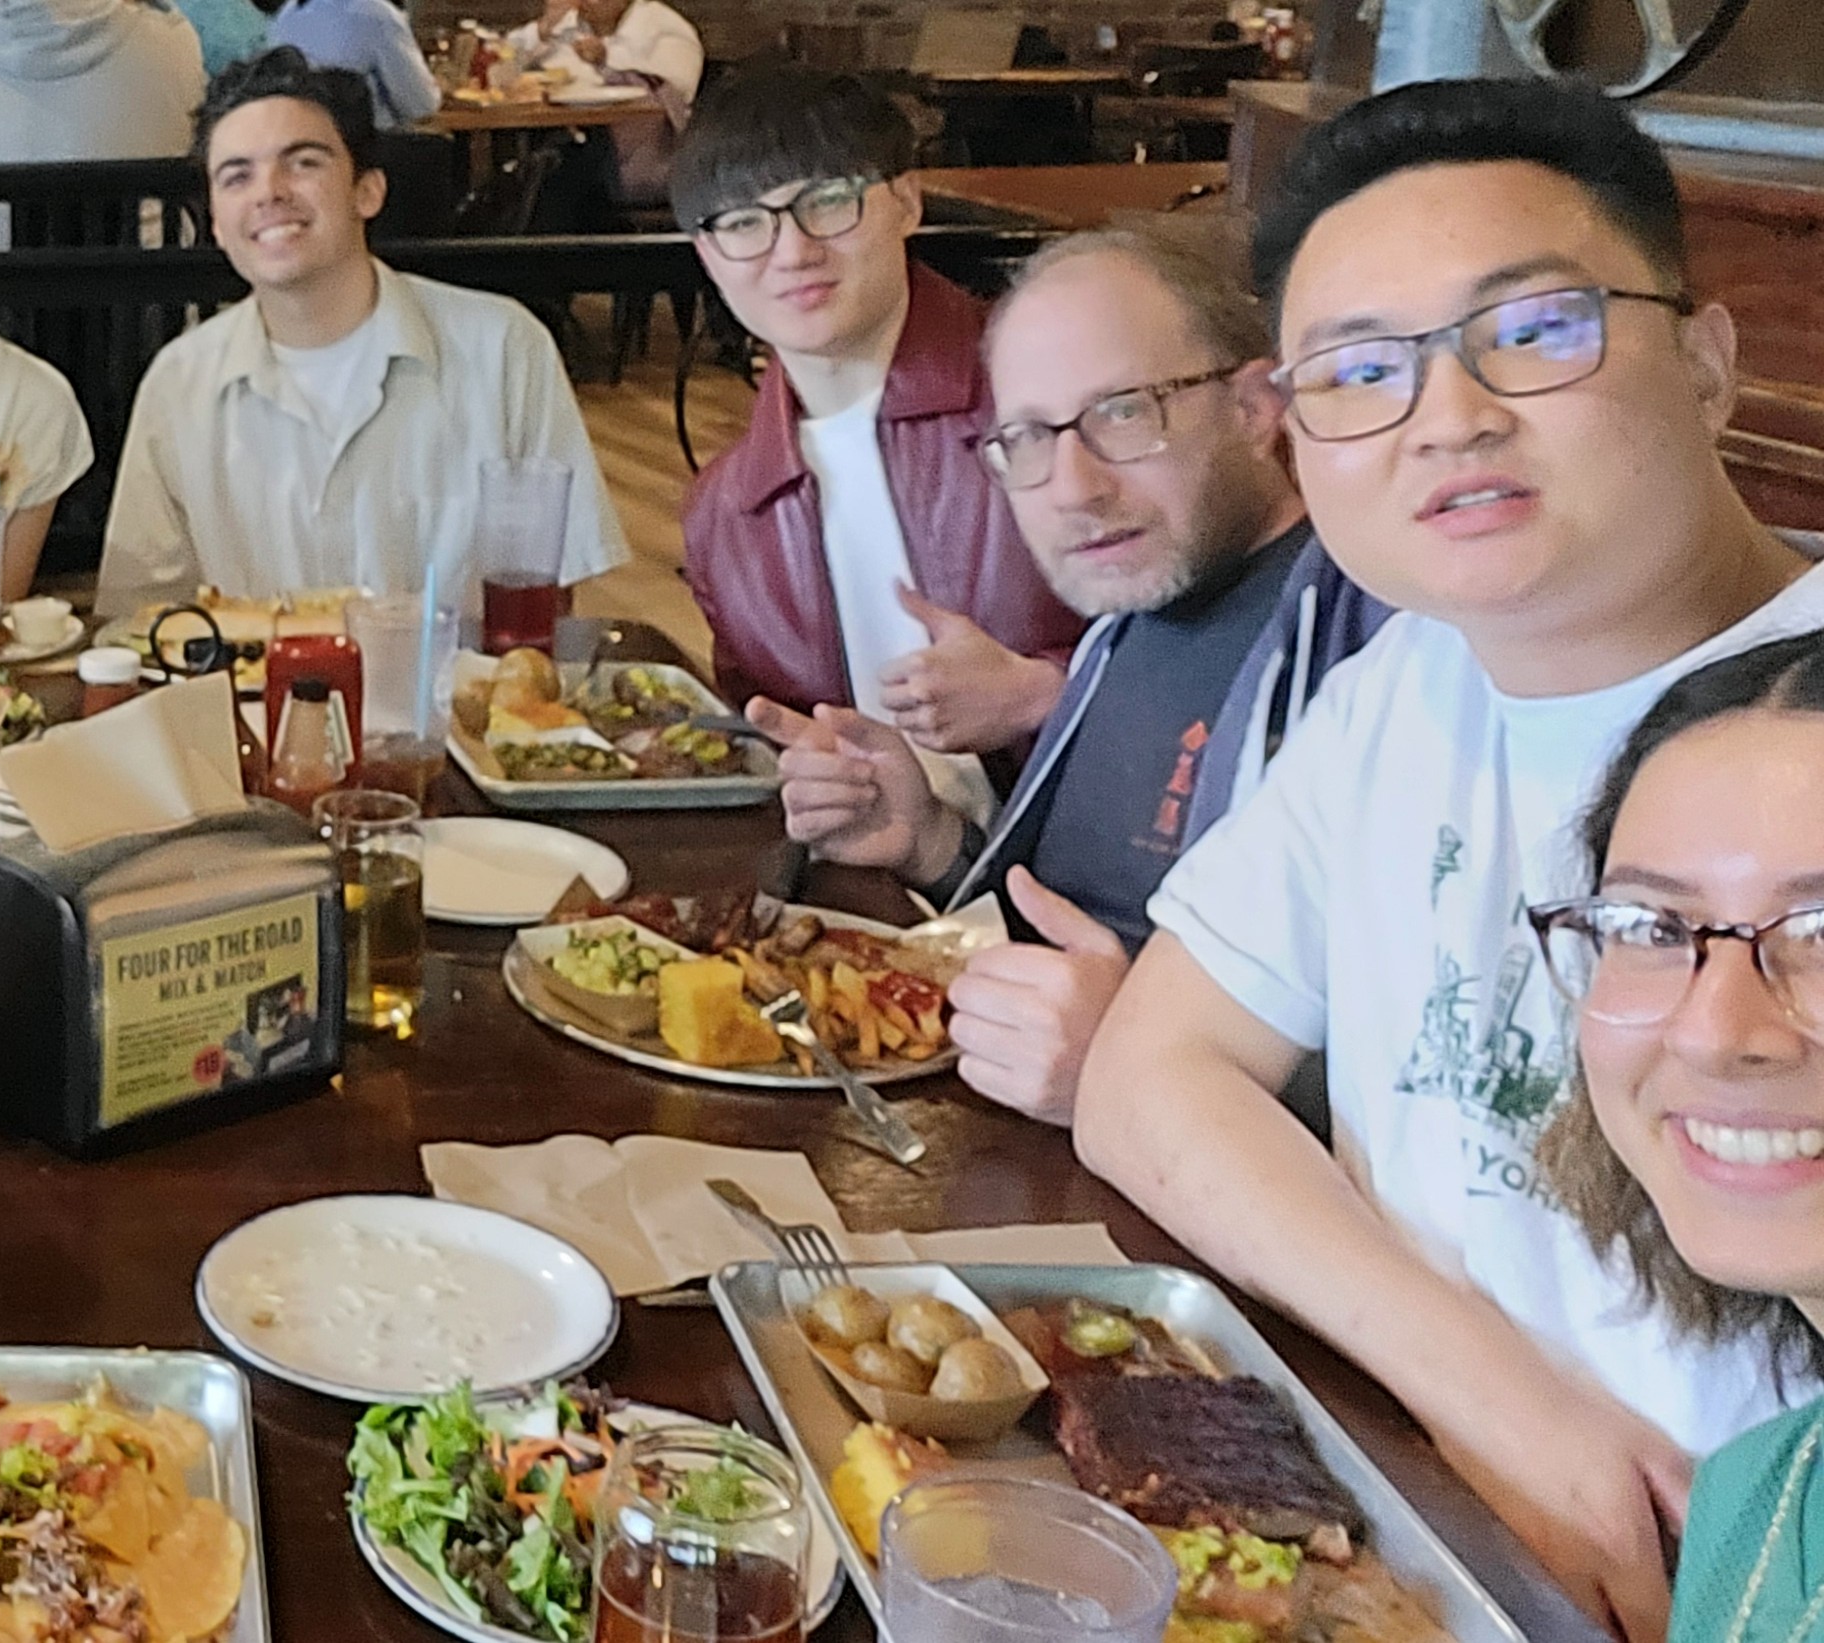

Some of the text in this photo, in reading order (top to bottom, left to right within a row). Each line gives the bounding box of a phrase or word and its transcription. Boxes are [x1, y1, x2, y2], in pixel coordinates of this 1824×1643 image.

[118, 916, 303, 983] FOUR FOR THE ROAD
[159, 959, 267, 1002] MIX & MATCH
[1478, 1143, 1561, 1213] YOR
